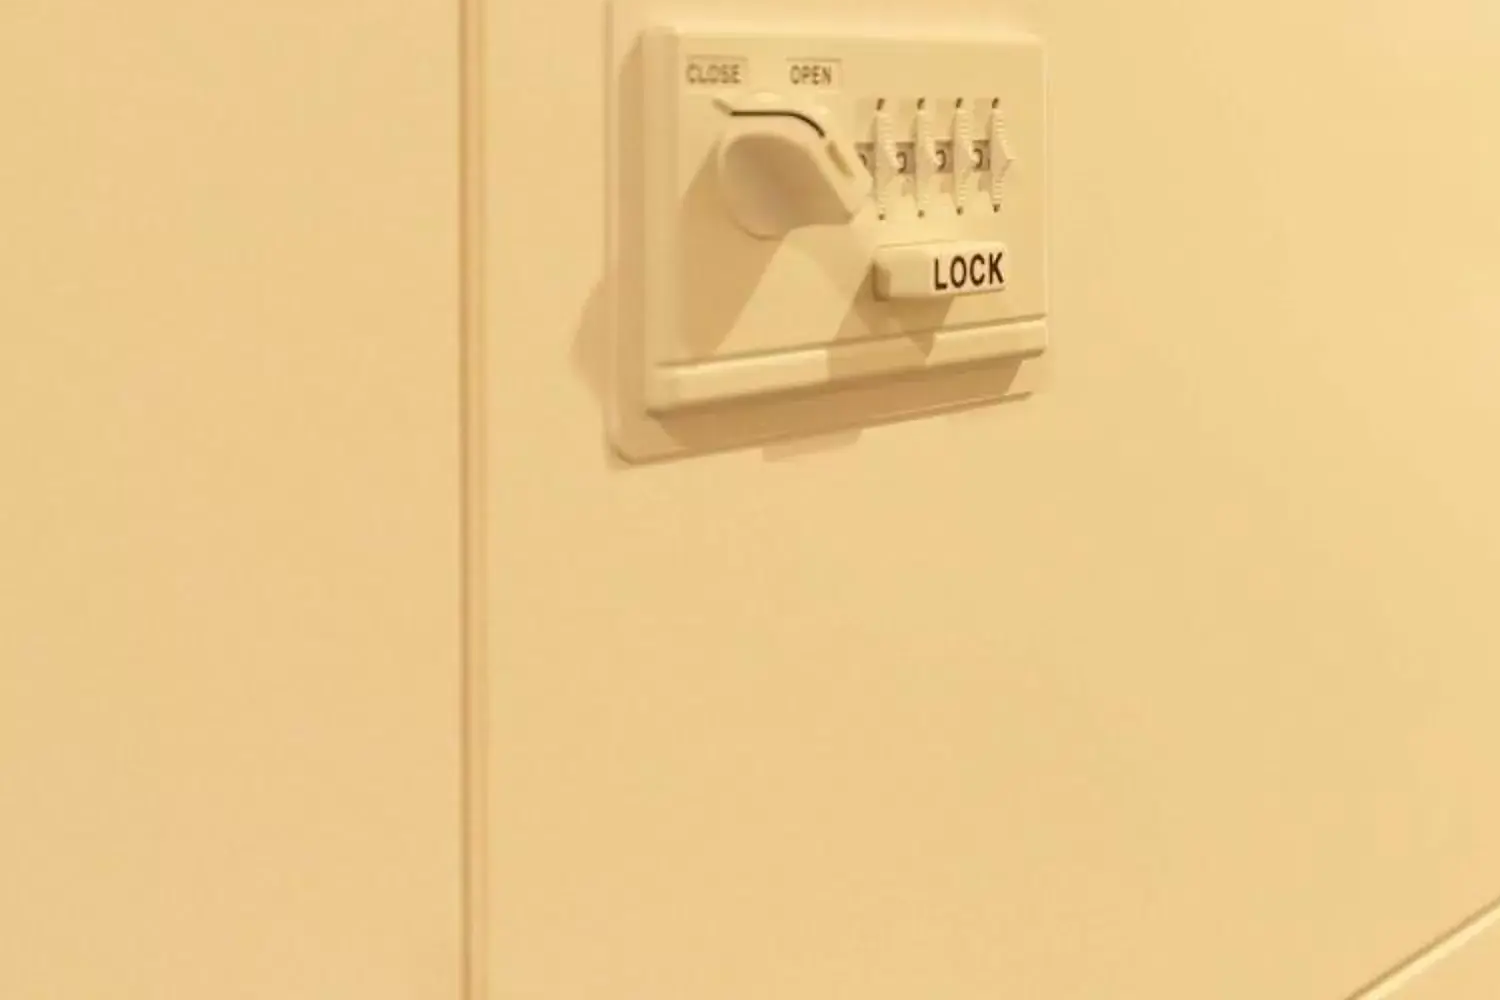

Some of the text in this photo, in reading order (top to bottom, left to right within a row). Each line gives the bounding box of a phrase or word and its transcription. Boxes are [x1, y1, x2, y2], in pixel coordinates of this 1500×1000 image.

[687, 63, 741, 84] CLOSE
[790, 64, 832, 86] OPEN
[934, 251, 1005, 291] LOCK
